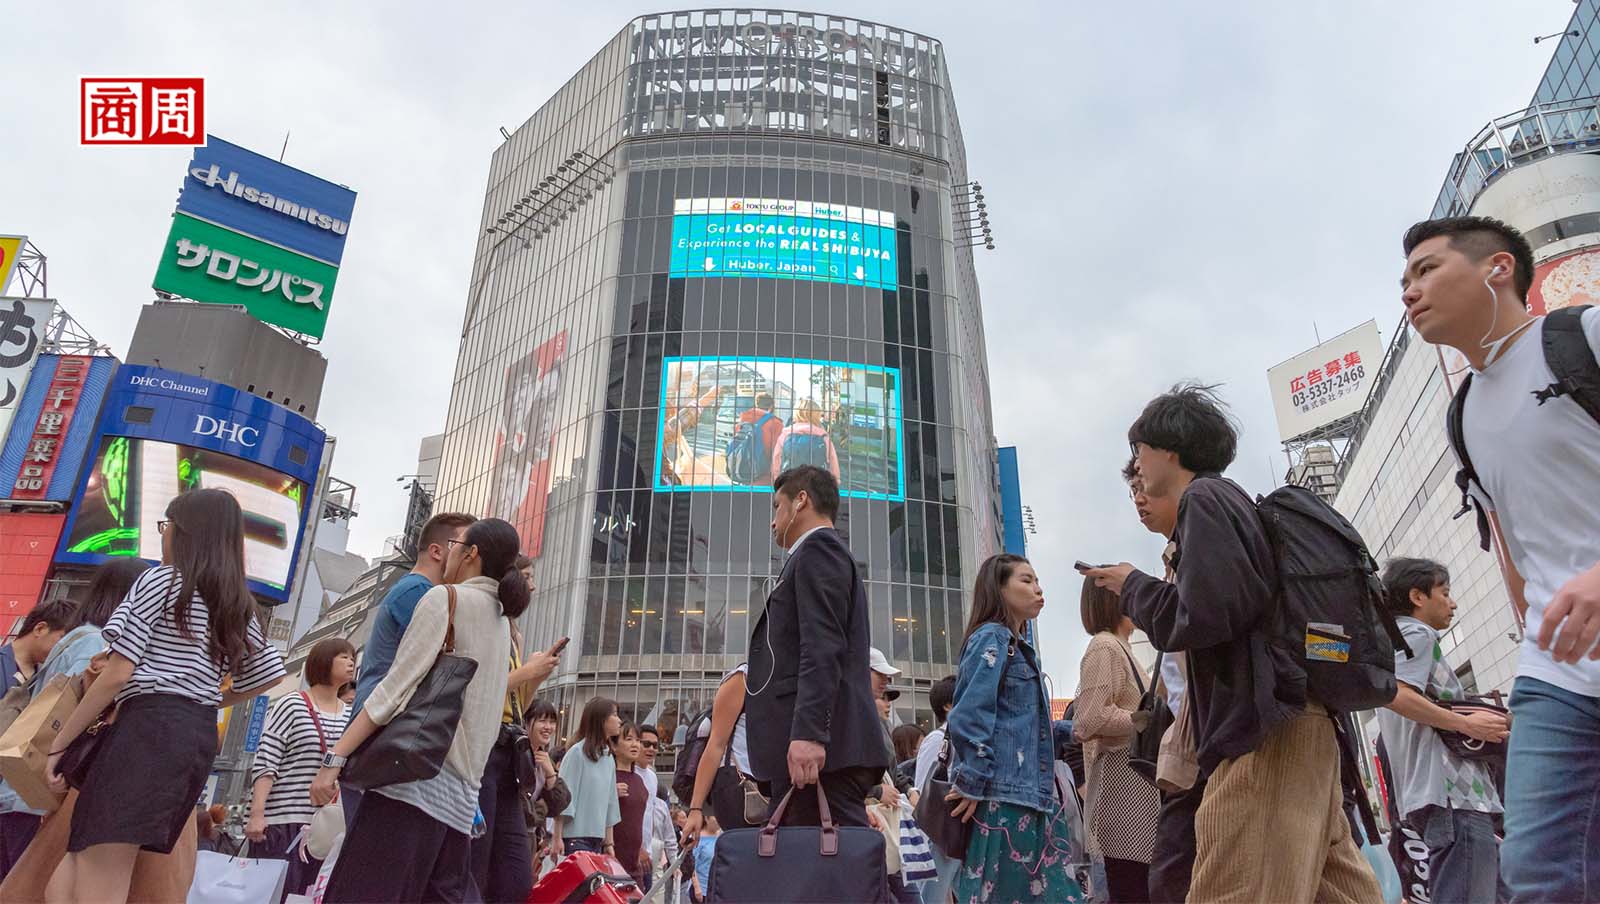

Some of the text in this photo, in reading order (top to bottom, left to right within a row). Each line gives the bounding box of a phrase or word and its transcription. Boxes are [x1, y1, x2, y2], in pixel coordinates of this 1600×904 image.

[190, 164, 348, 236] Hisamitsu
[677, 238, 891, 261] Experience the REAL SHIBUYA
[707, 223, 861, 242] Get LOCAL GUIDES &
[175, 237, 325, 311] サロンパス
[728, 260, 817, 273] Huber. Japan
[130, 375, 208, 396] DHC Channel
[1290, 350, 1361, 394] 広告募集
[1292, 365, 1365, 407] 03-5337-2468
[15, 359, 84, 490] 三千里薬品
[192, 415, 260, 448] DHC
